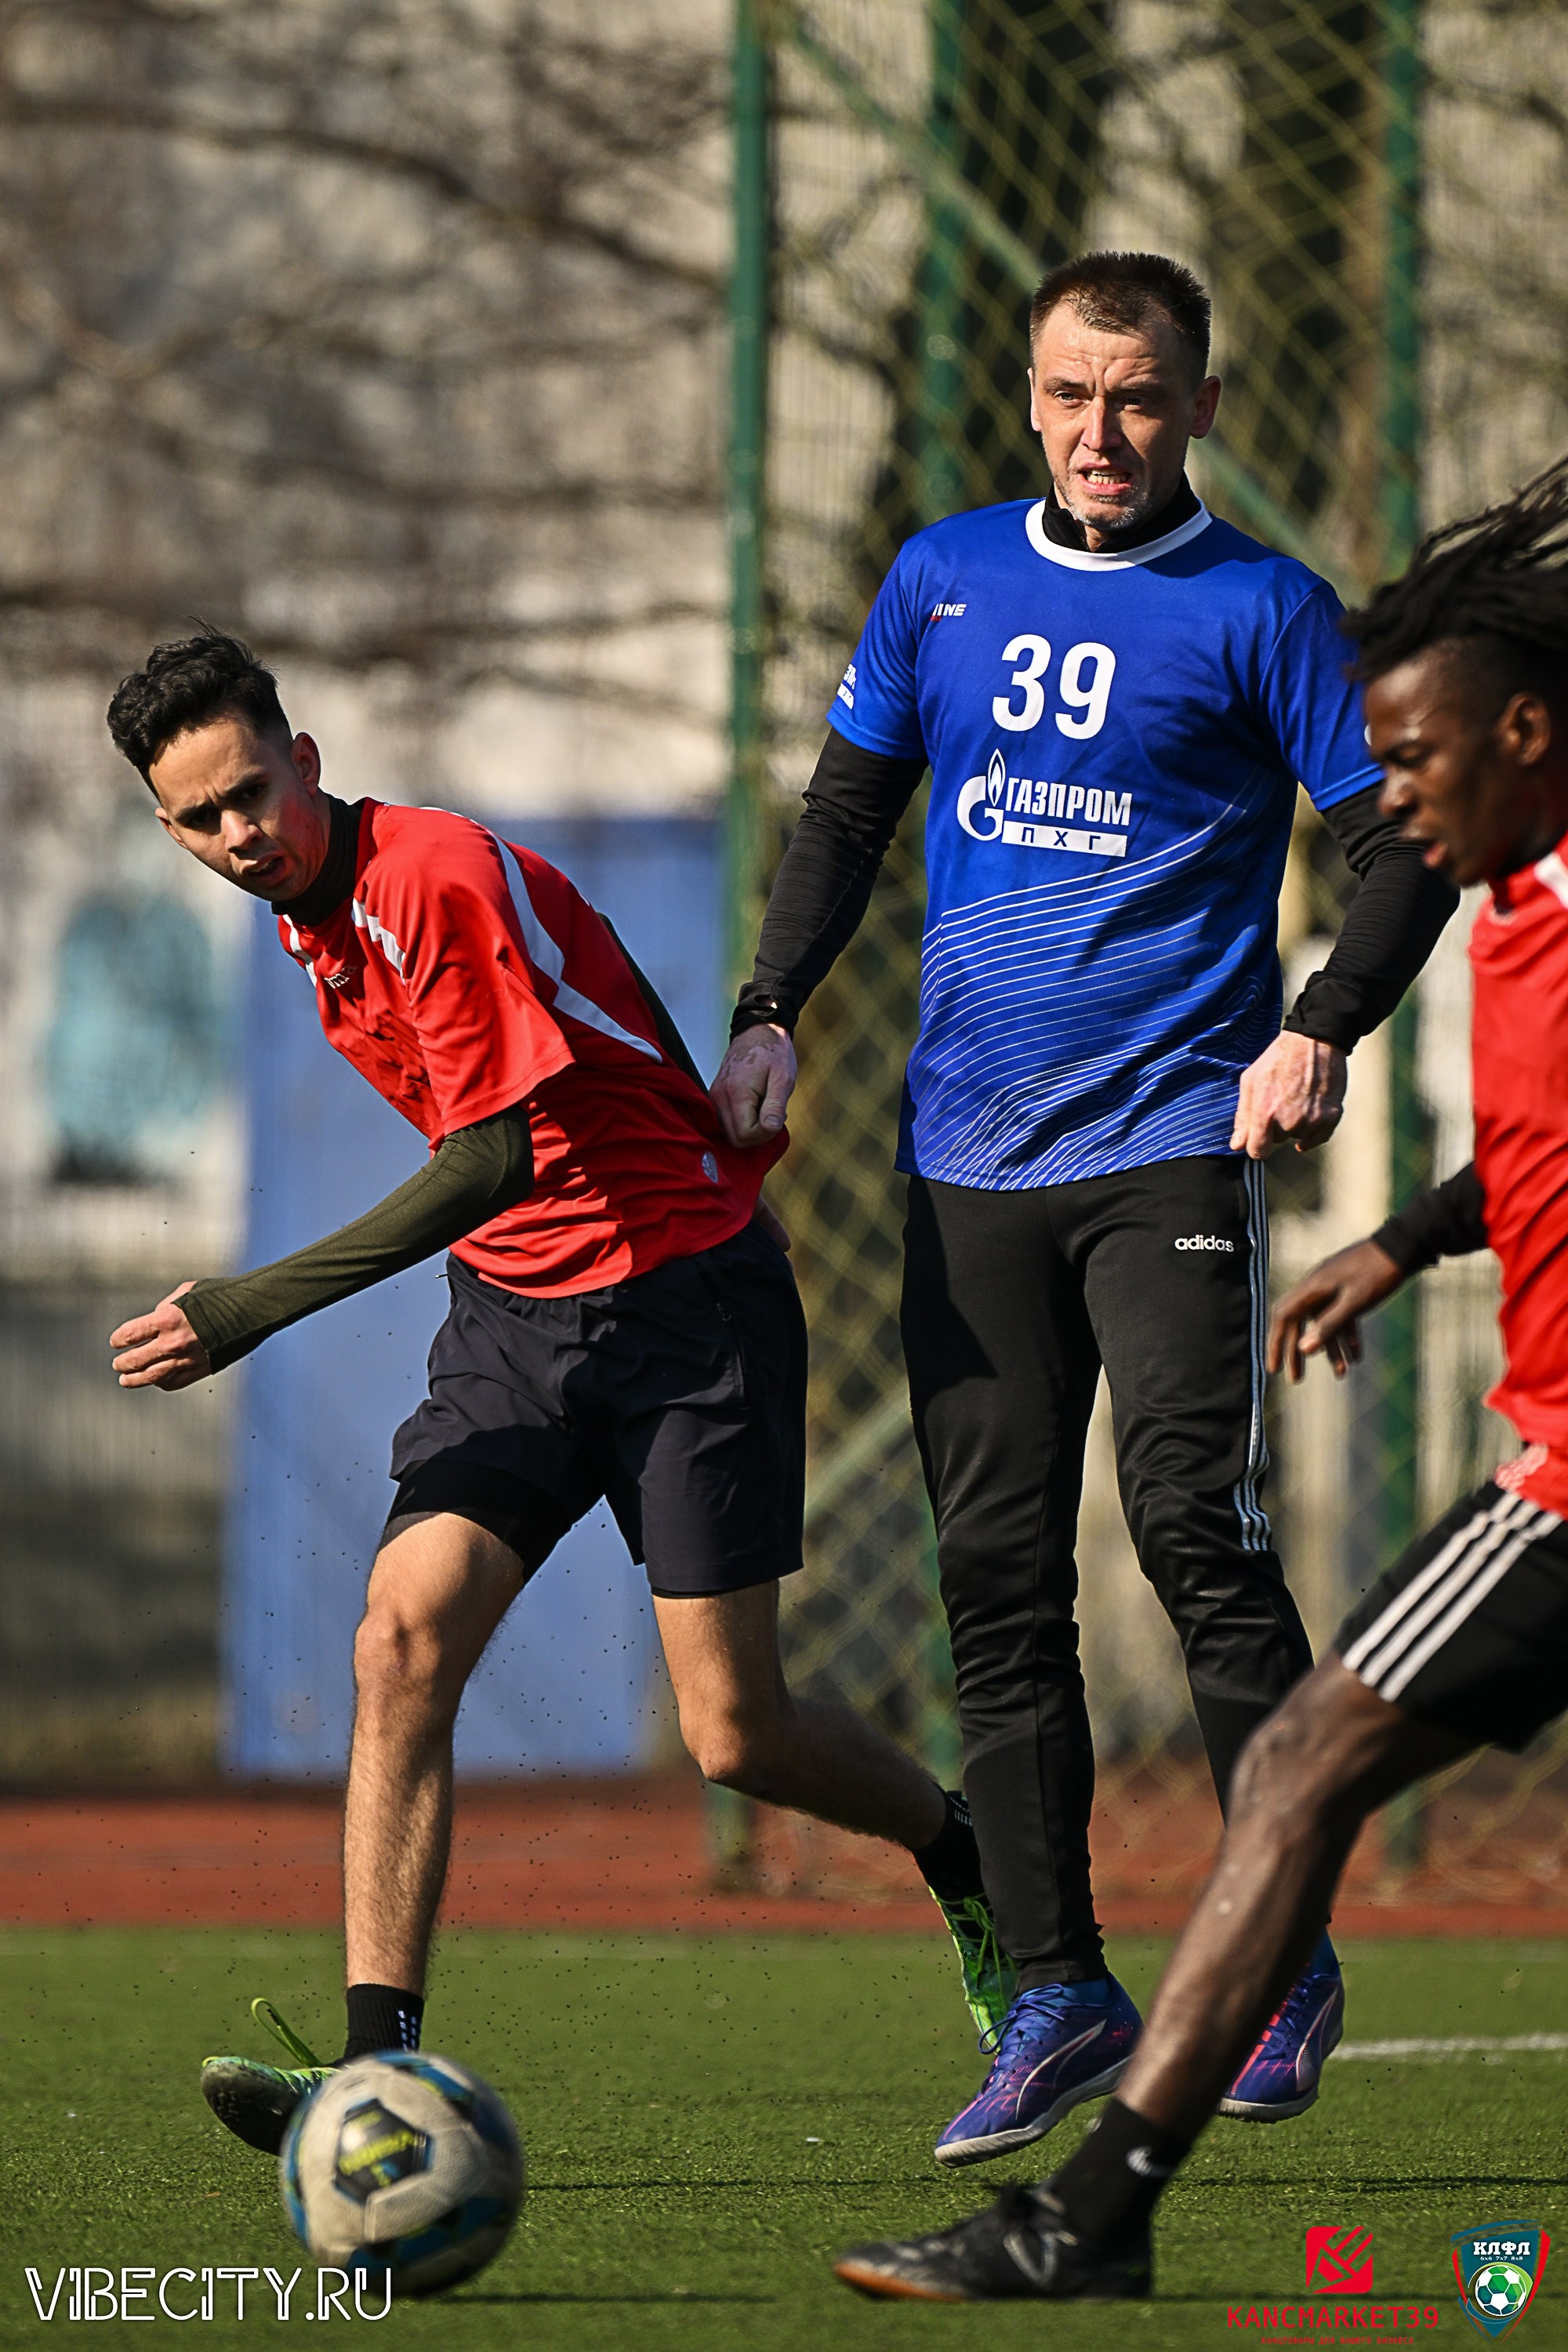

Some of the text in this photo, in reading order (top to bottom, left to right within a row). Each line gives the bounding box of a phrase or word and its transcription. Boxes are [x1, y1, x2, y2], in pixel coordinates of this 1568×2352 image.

[992, 633, 1116, 740] 39
[1005, 777, 1133, 826] ГАЗПРОМ
[1174, 1234, 1235, 1253] adidas
